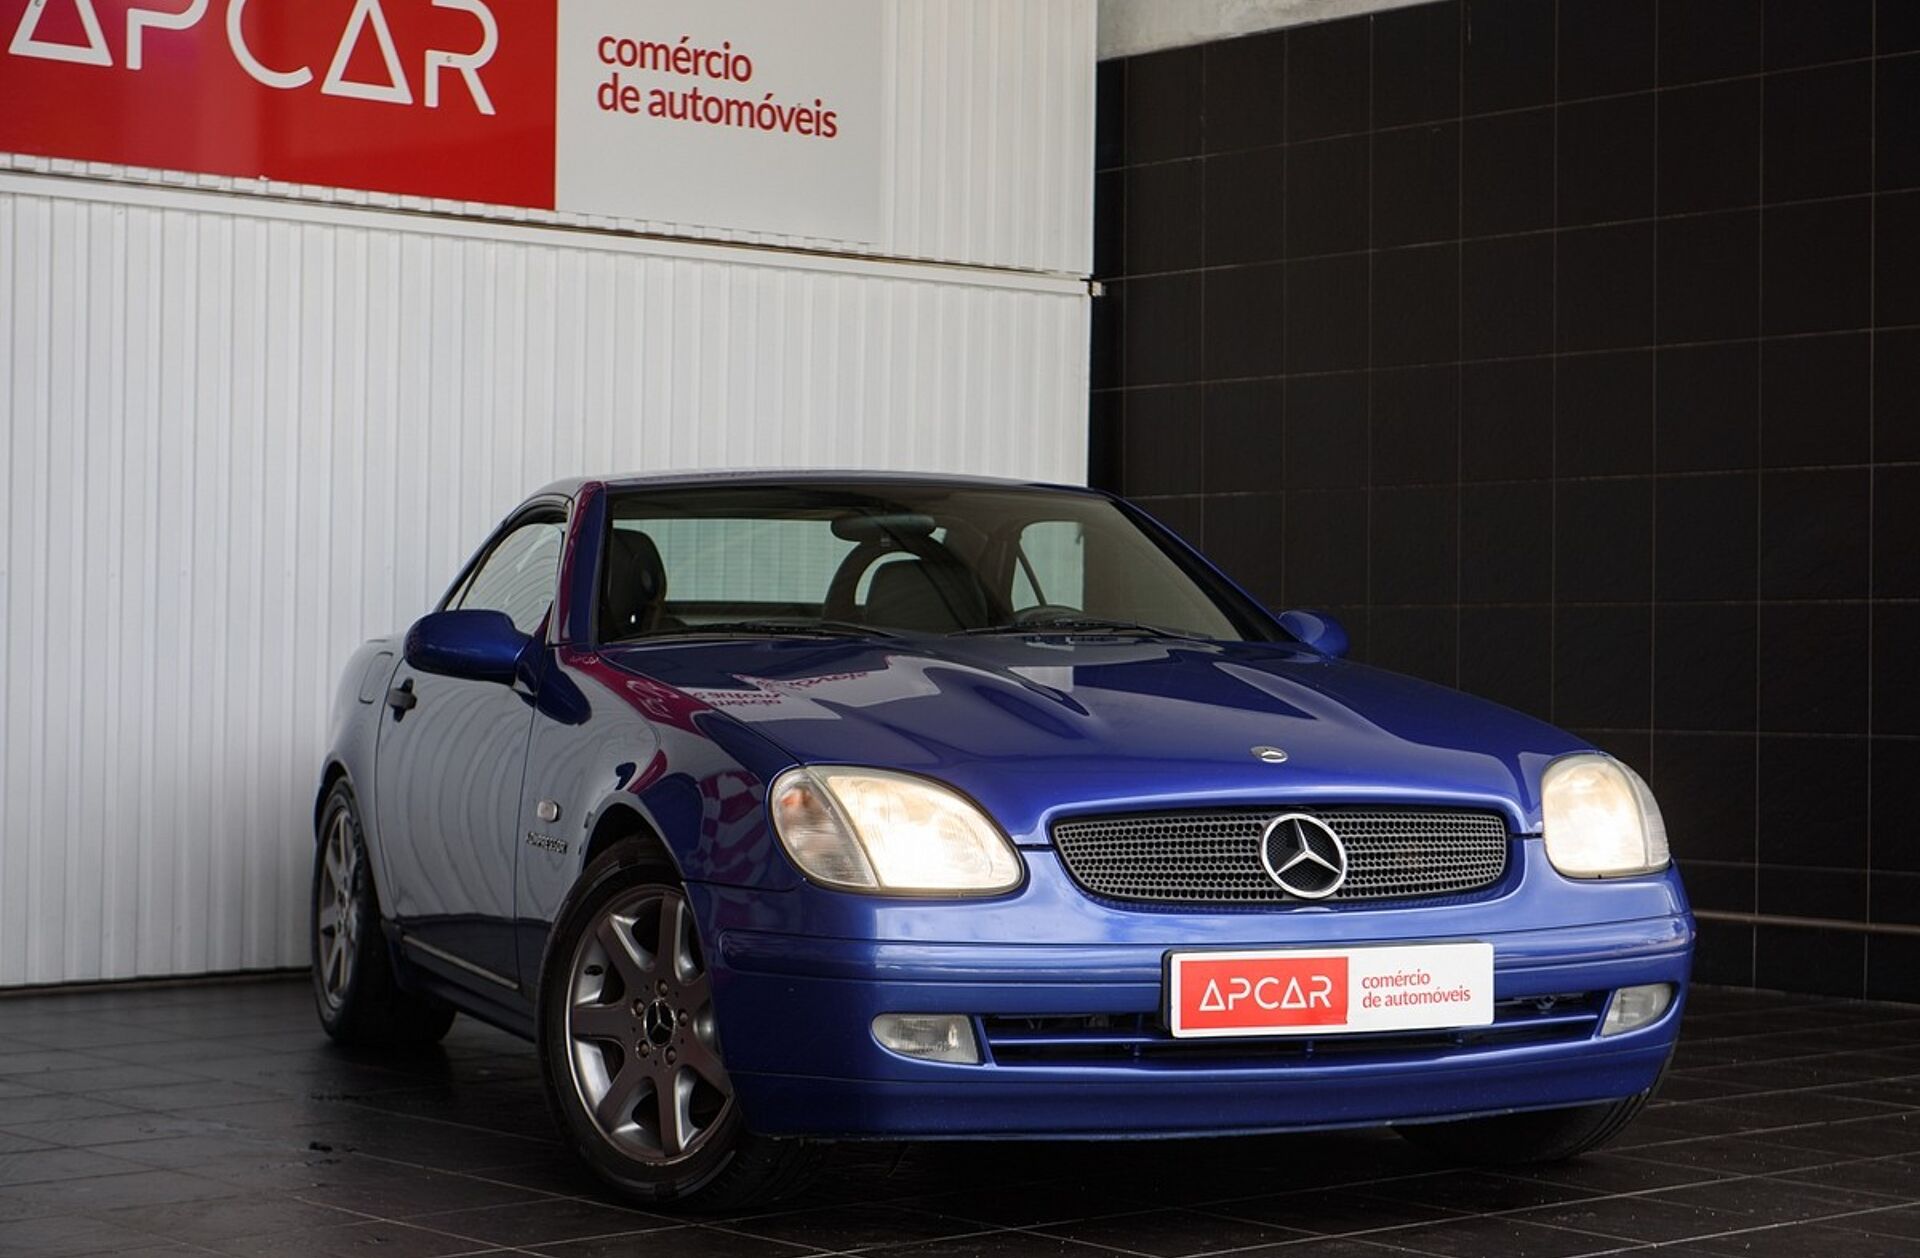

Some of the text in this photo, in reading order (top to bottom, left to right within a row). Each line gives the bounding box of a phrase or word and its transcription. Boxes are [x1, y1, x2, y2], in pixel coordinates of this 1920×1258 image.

[597, 35, 753, 83] comércio
[597, 72, 838, 138] de automóveis
[1199, 975, 1334, 1012] APCAR
[1361, 969, 1431, 988] comércio
[1361, 986, 1471, 1009] de automóveis
